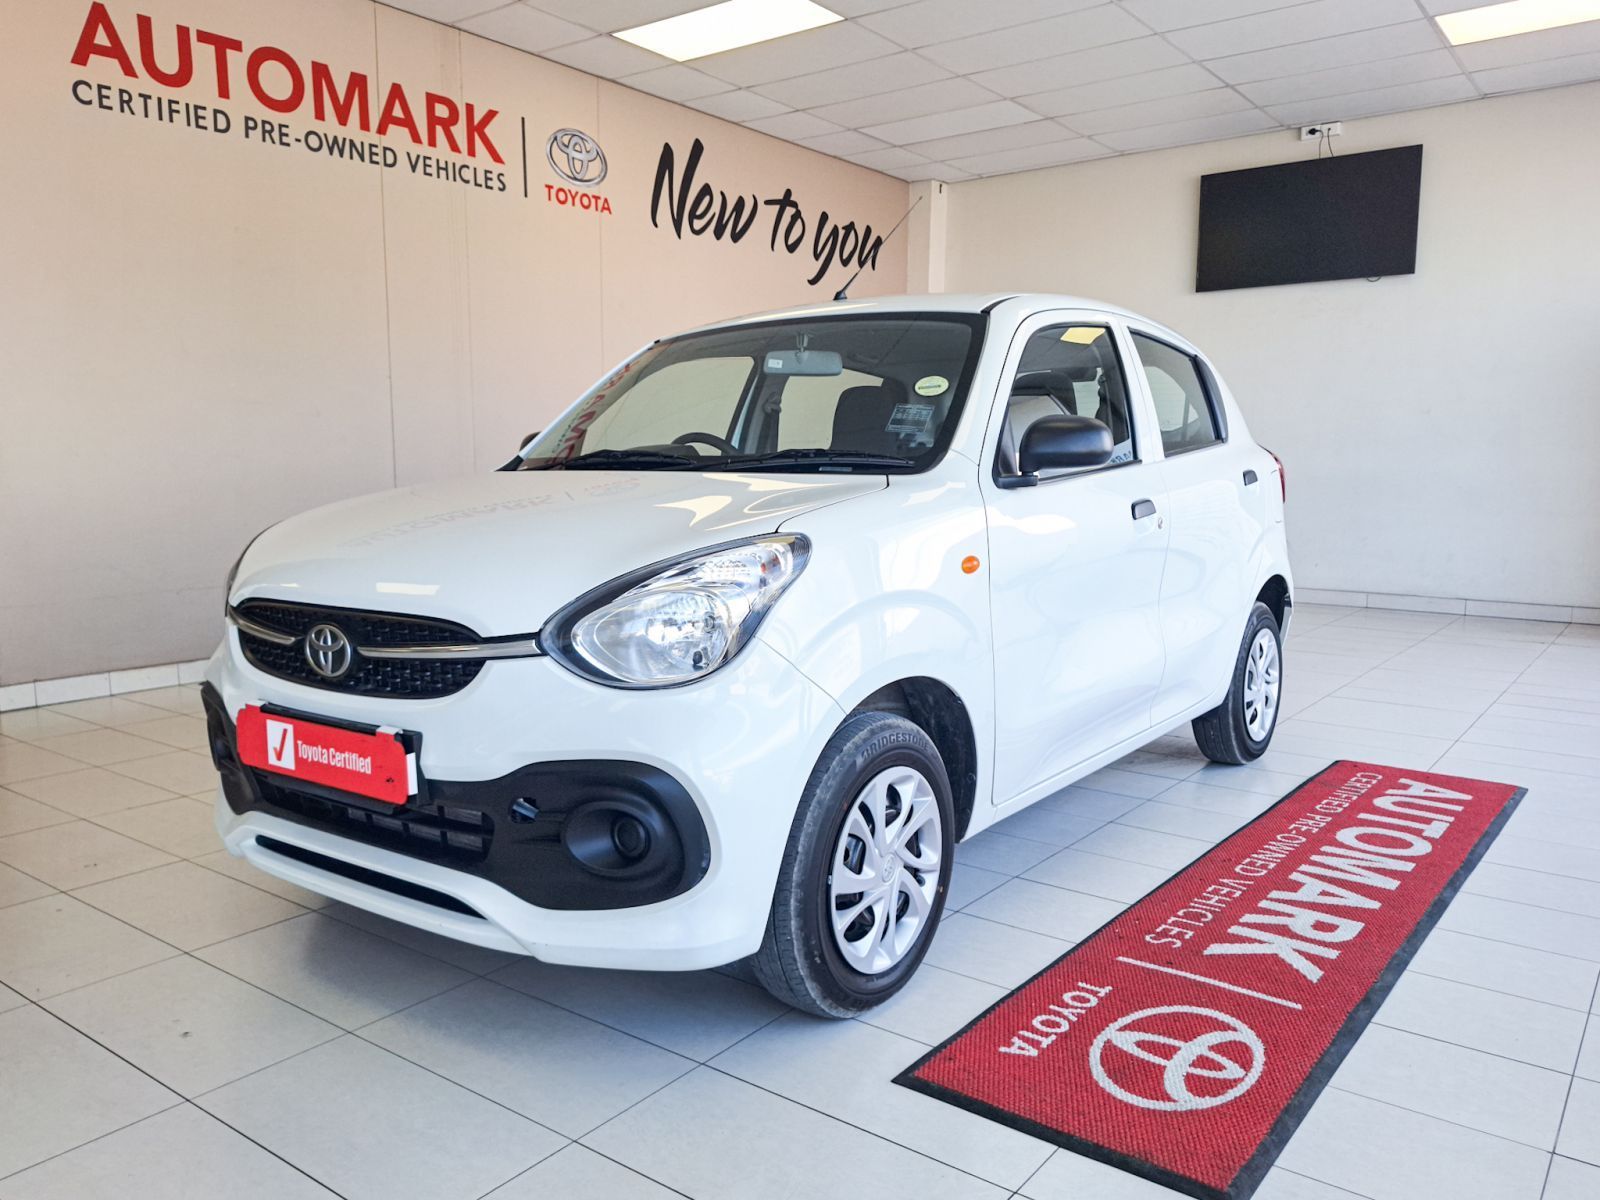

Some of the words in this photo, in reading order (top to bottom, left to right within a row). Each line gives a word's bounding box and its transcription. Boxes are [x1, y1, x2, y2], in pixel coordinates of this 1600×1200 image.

[70, 1, 505, 165] AUTOMARK
[71, 79, 232, 134] CERTIFIED
[243, 115, 399, 169] PRE-OWNED
[405, 151, 507, 193] VEHICLES
[544, 184, 613, 215] TOYOTA
[650, 138, 759, 244] New
[763, 188, 807, 254] to
[807, 211, 883, 286] you
[296, 740, 328, 764] Toyota
[329, 748, 372, 775] Certified
[1313, 771, 1383, 814] CERTIFIED
[1203, 777, 1474, 984] AUTOMARK
[1234, 812, 1332, 877] PRE-OWNED
[1144, 878, 1254, 949] VEHICLES
[998, 980, 1113, 1057] TOYOTA
